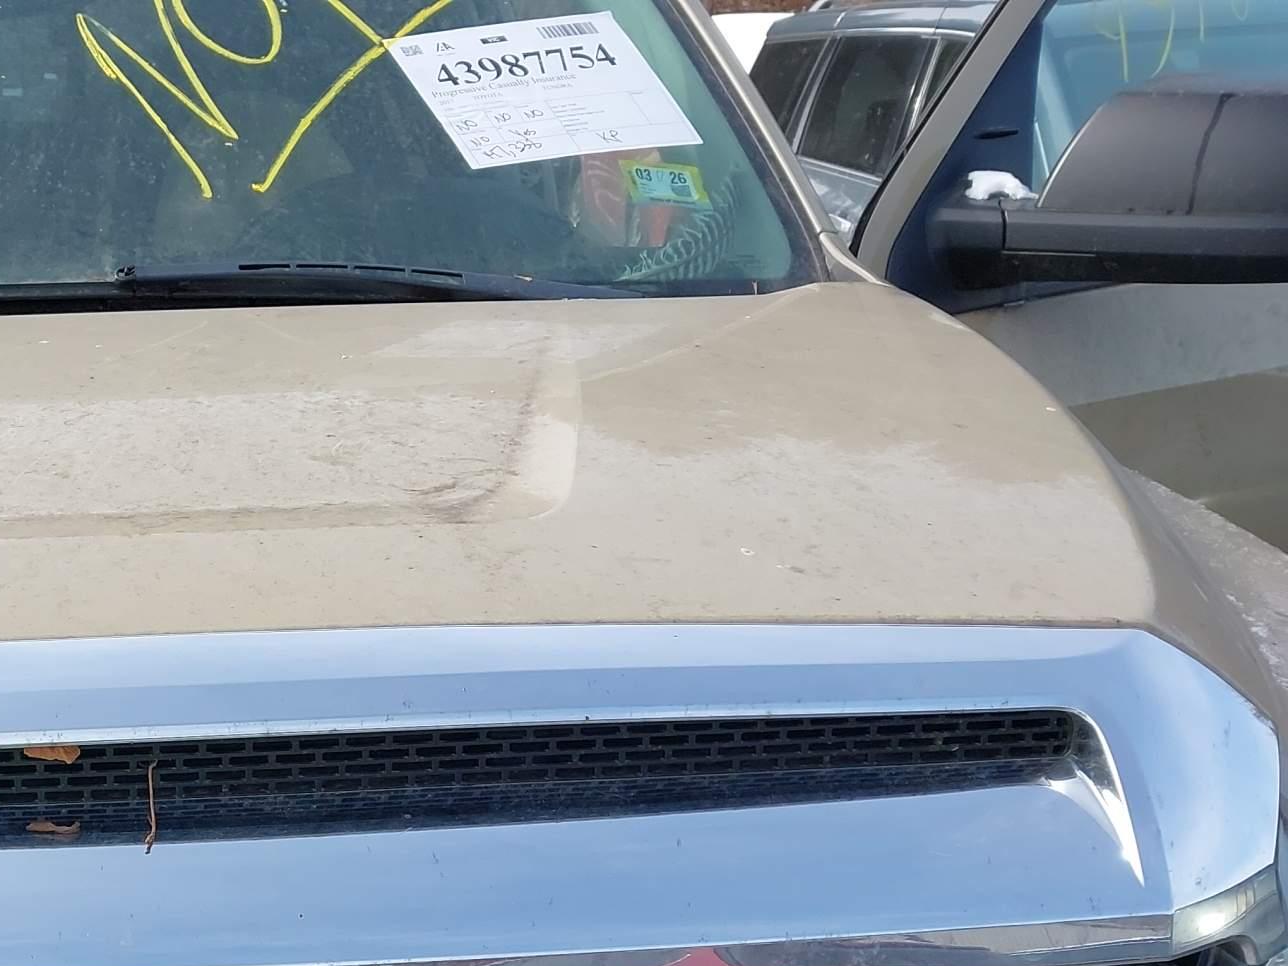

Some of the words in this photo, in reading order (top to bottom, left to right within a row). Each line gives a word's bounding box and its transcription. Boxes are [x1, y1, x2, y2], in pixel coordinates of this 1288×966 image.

[437, 43, 617, 86] 43987754
[431, 85, 488, 99] Progressive
[488, 78, 531, 91] Casualty
[532, 73, 577, 85] Insurance
[494, 112, 512, 123] NO
[523, 109, 544, 120] NO
[455, 119, 478, 132] NO
[635, 167, 653, 182] 03
[669, 171, 688, 185] 26
